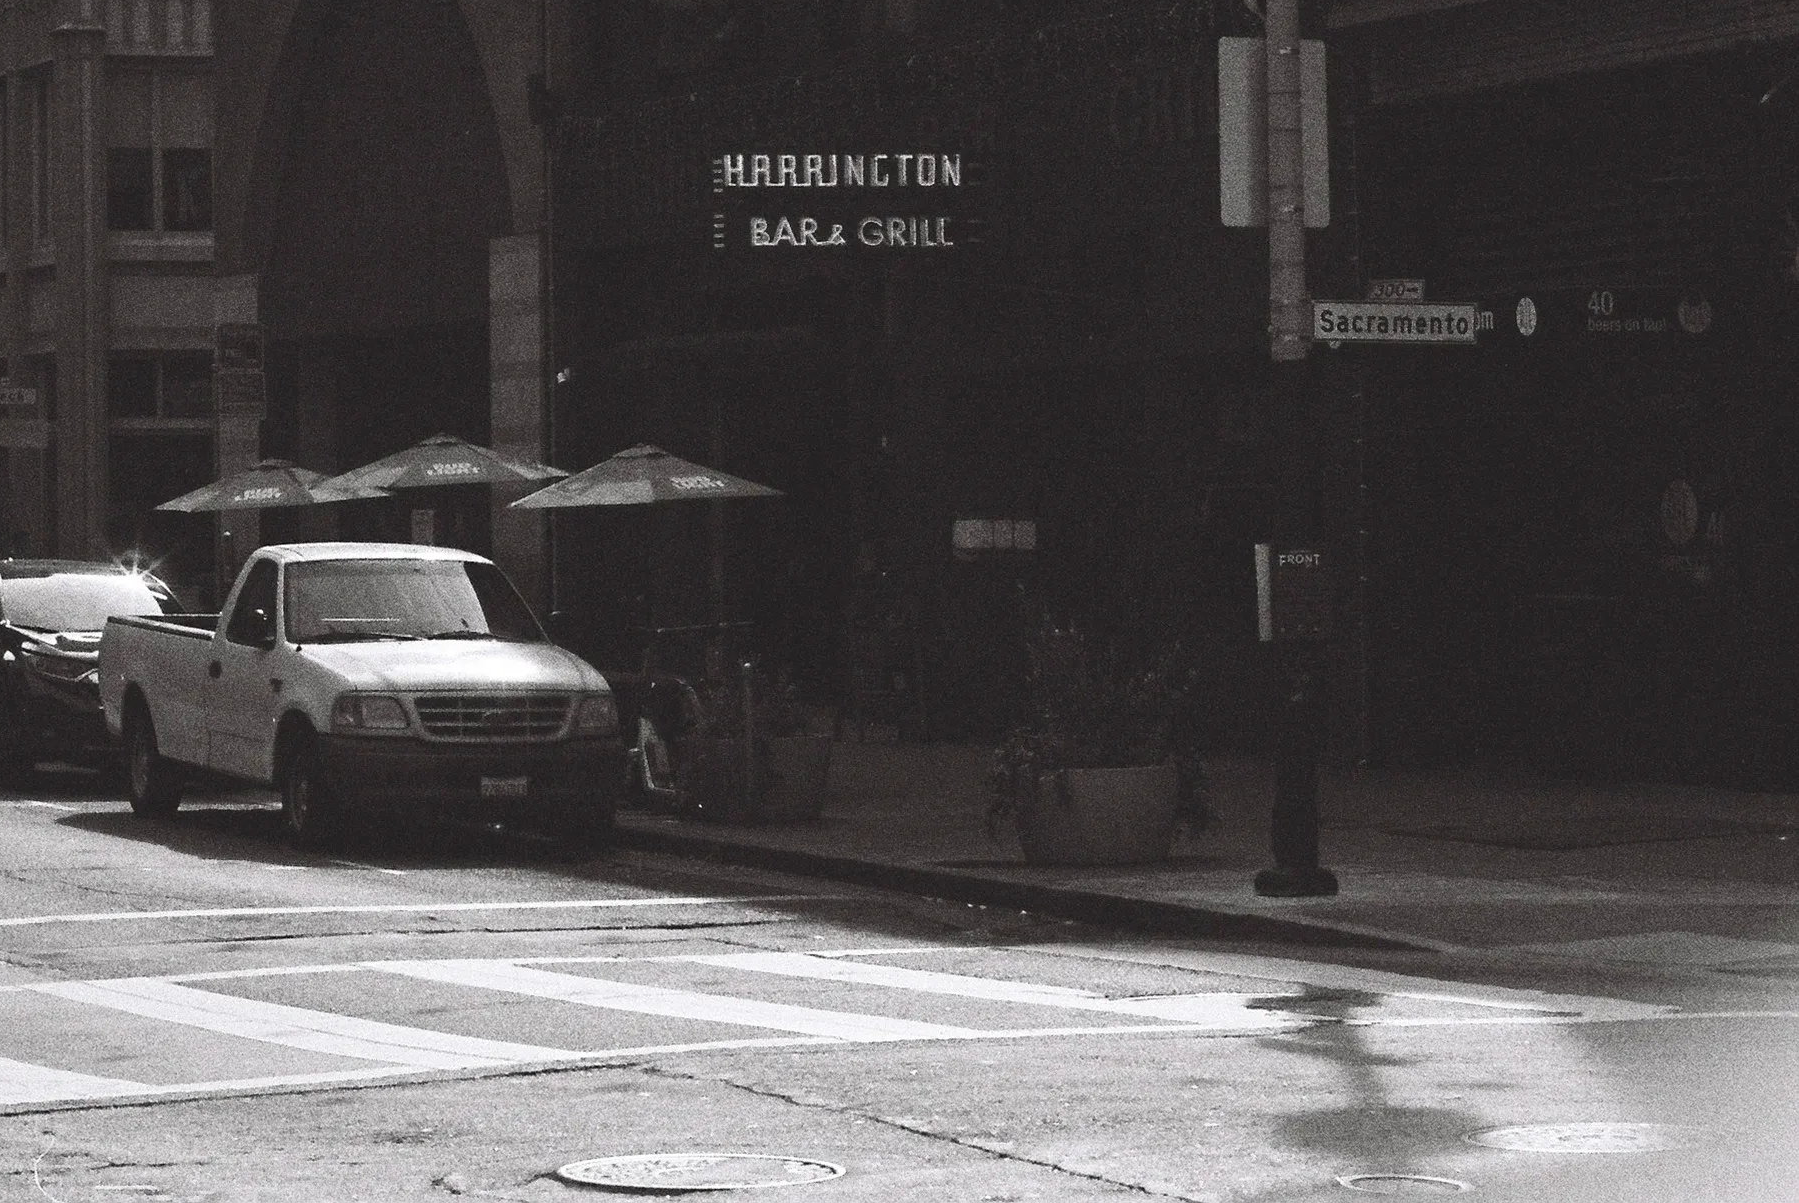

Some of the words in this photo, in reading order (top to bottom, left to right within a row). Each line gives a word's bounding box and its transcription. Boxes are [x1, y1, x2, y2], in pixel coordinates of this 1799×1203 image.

[723, 154, 961, 187] HARRINGTON
[858, 216, 953, 246] GRILL
[1587, 290, 1614, 315] 40
[1320, 309, 1468, 334] Sacramento
[1278, 553, 1320, 567] FRONT
